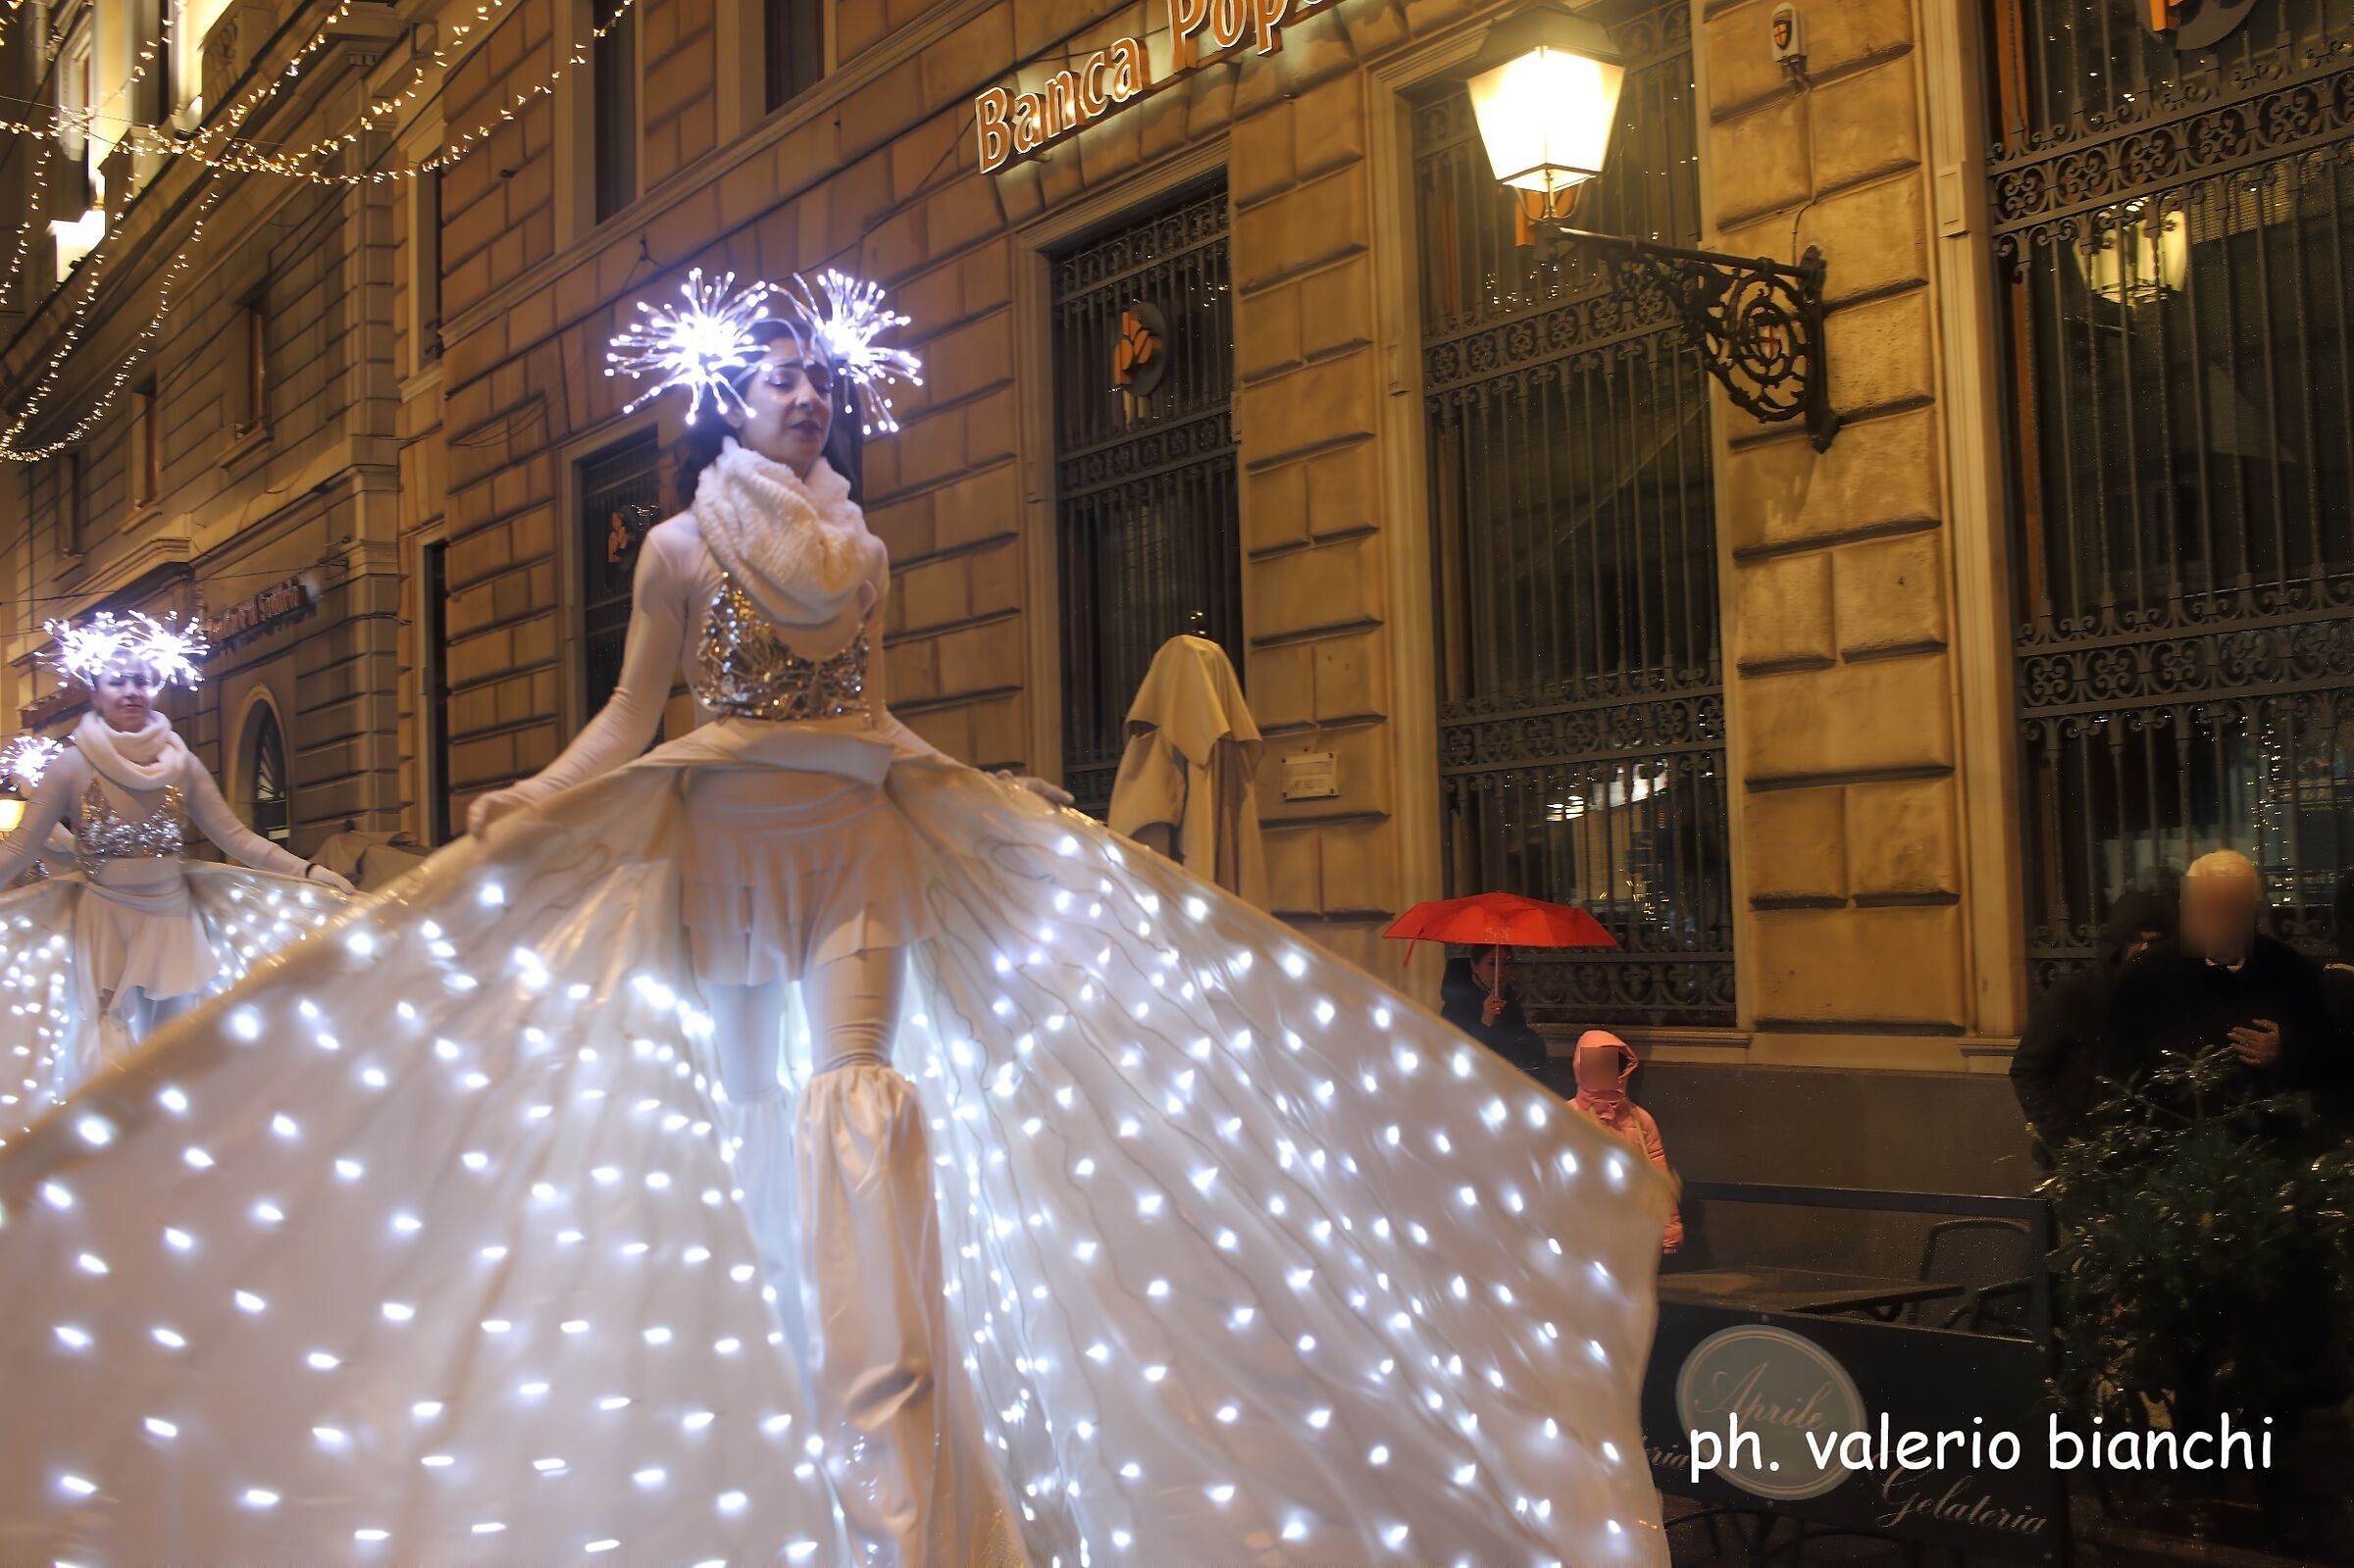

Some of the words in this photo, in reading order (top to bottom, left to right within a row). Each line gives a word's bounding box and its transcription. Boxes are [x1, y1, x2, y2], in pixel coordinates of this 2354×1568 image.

[974, 37, 1147, 175] Banca
[1167, 0, 1324, 71] Pop
[1694, 1361, 1834, 1433] Aprile
[1871, 1451, 2049, 1536] Gelateria
